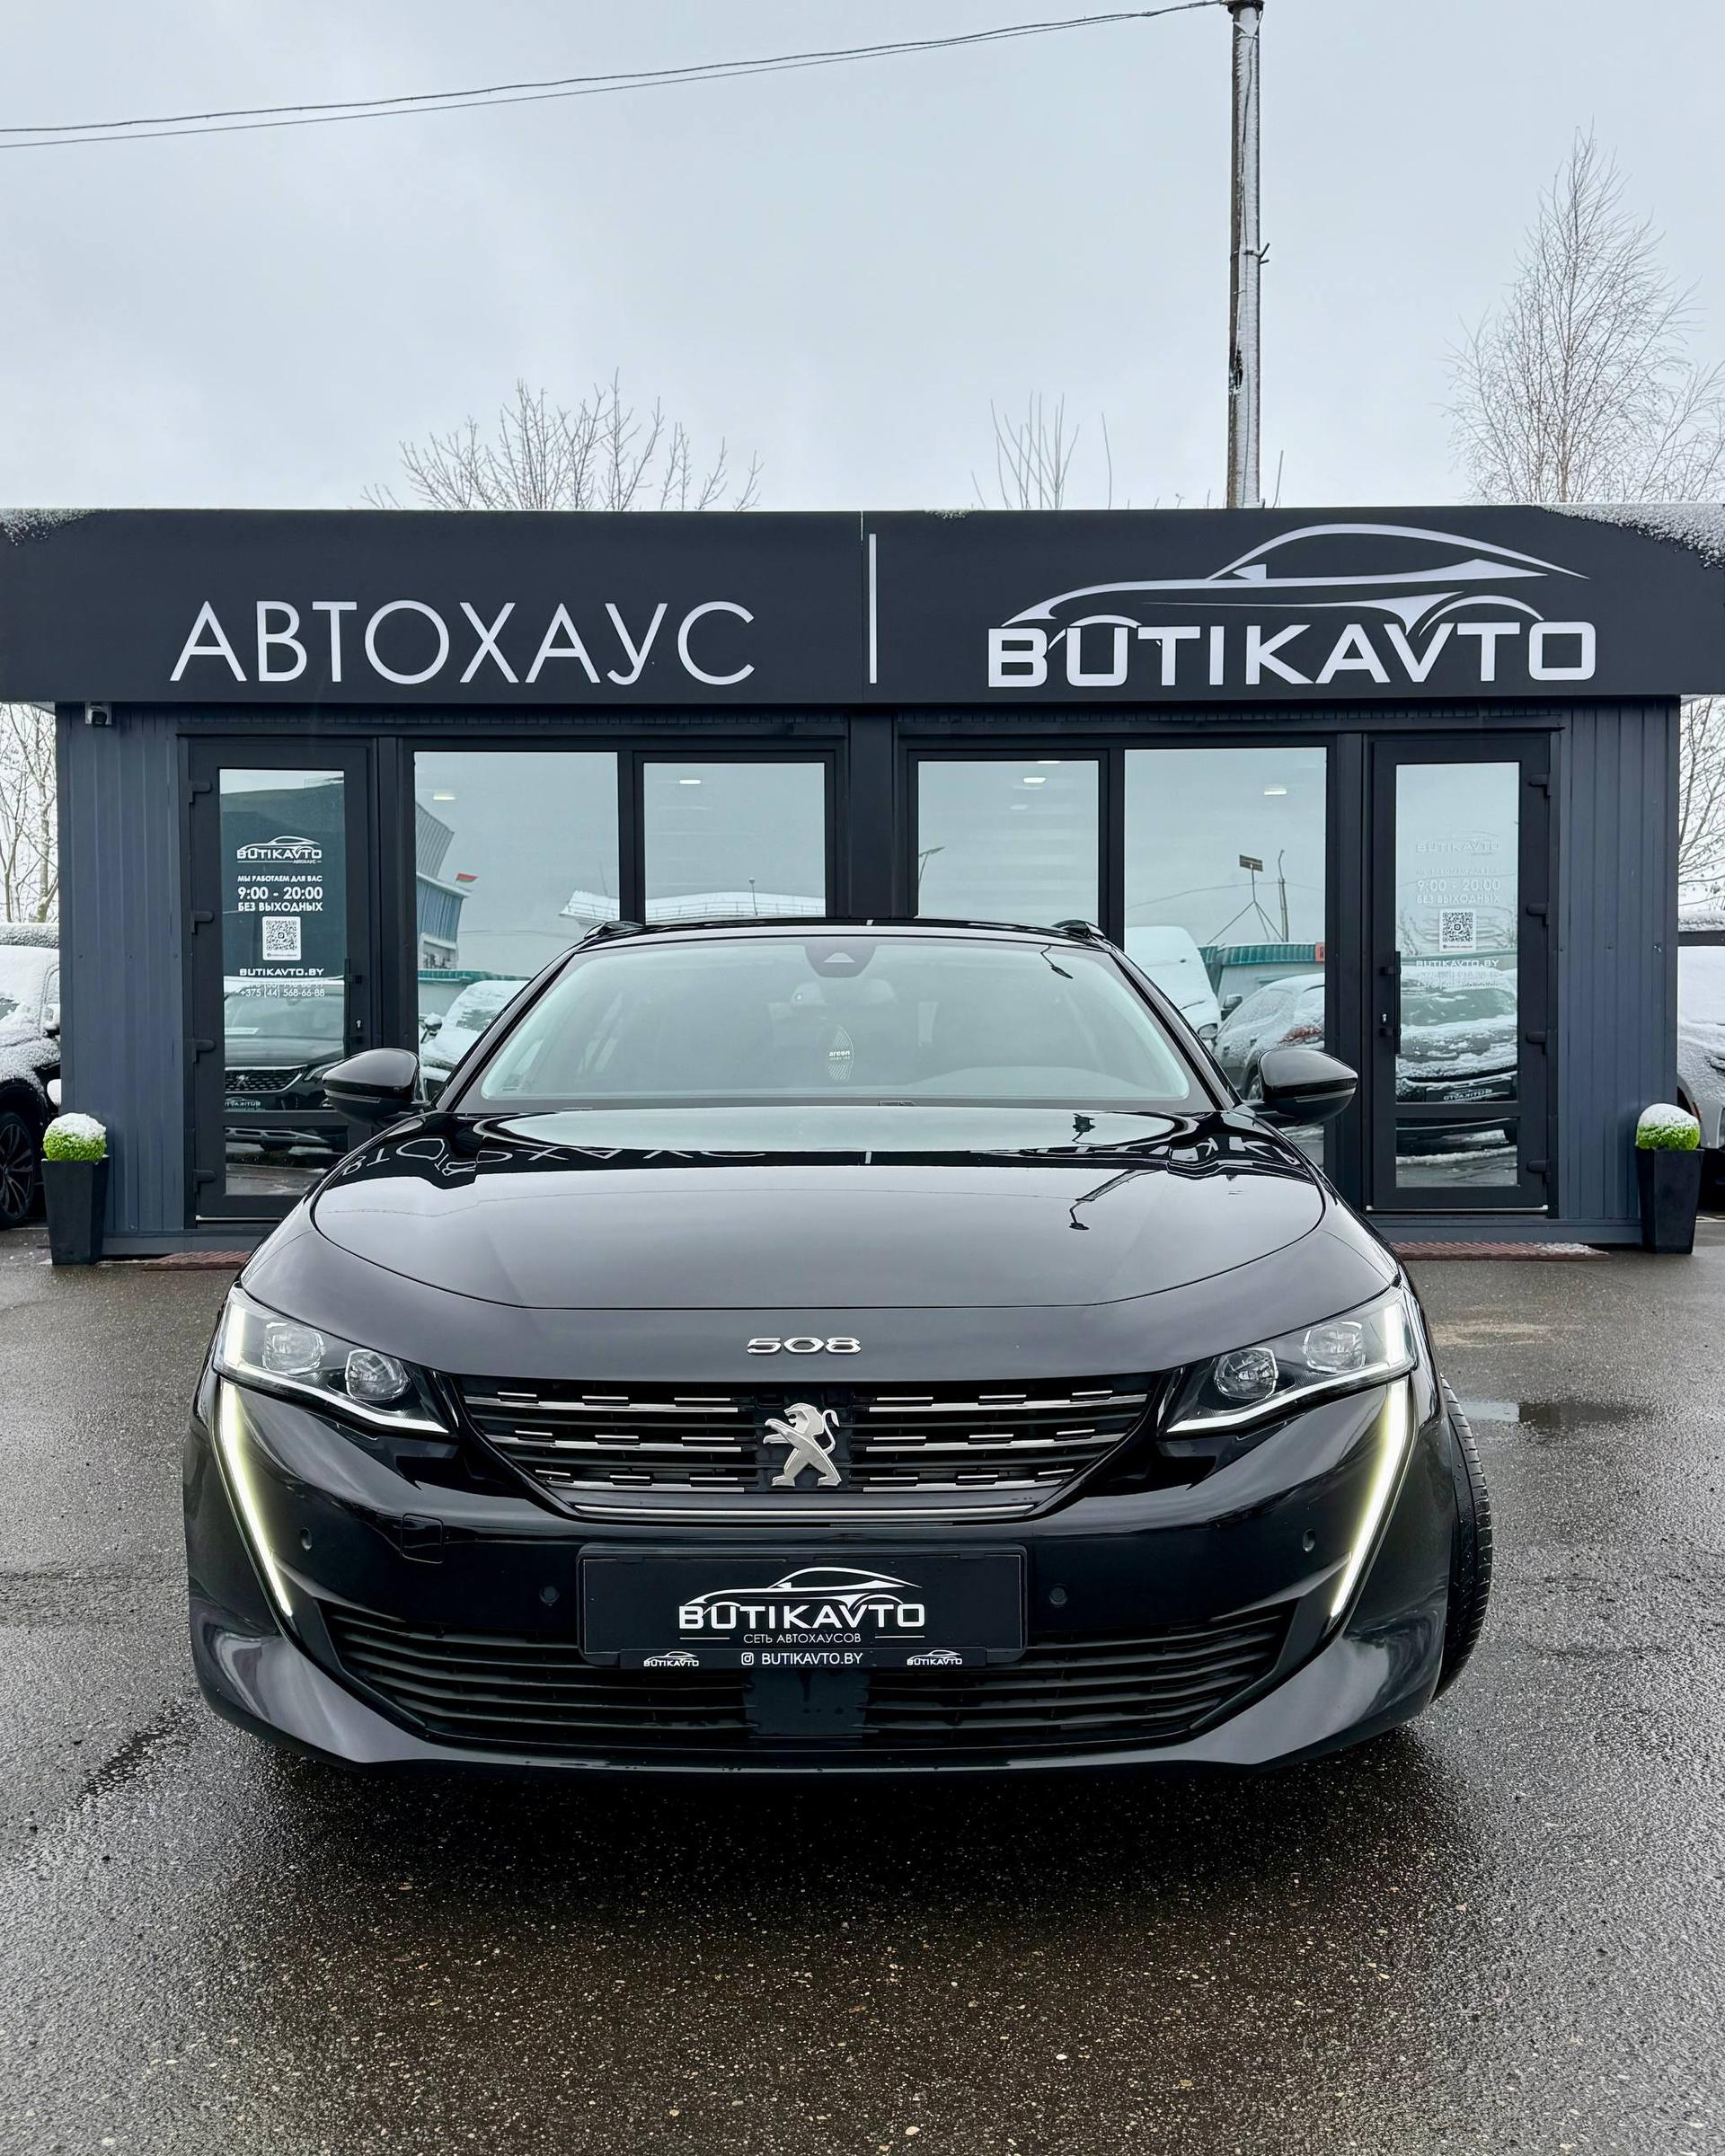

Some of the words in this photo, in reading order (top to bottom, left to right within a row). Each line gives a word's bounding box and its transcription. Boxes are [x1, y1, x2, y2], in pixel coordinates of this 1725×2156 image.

[170, 599, 756, 686] АВТОХАУС
[987, 620, 1597, 688] BUTIKAVTO
[236, 849, 323, 860] BUTIKAVTO
[290, 875, 305, 883] ДЛЯ
[237, 886, 269, 900] 9:00
[283, 886, 323, 900] 20:00
[237, 902, 256, 912] БЕЗ
[258, 902, 323, 913] ВЫХОДНЫХ
[239, 968, 324, 976] BUTIKAVTO.BY
[263, 988, 281, 999] (44)
[283, 988, 325, 997] 568-66-88
[747, 1336, 862, 1356] 508
[678, 1604, 924, 1629] BUTIKAVTO
[743, 1633, 774, 1645] СЕТЬ
[776, 1633, 862, 1645] АВТОХАУСОВ
[643, 1659, 700, 1667] BUTIKAVTO
[761, 1652, 863, 1666] BUTIKAVTO.BY
[907, 1657, 963, 1666] BUTIKAVTO
